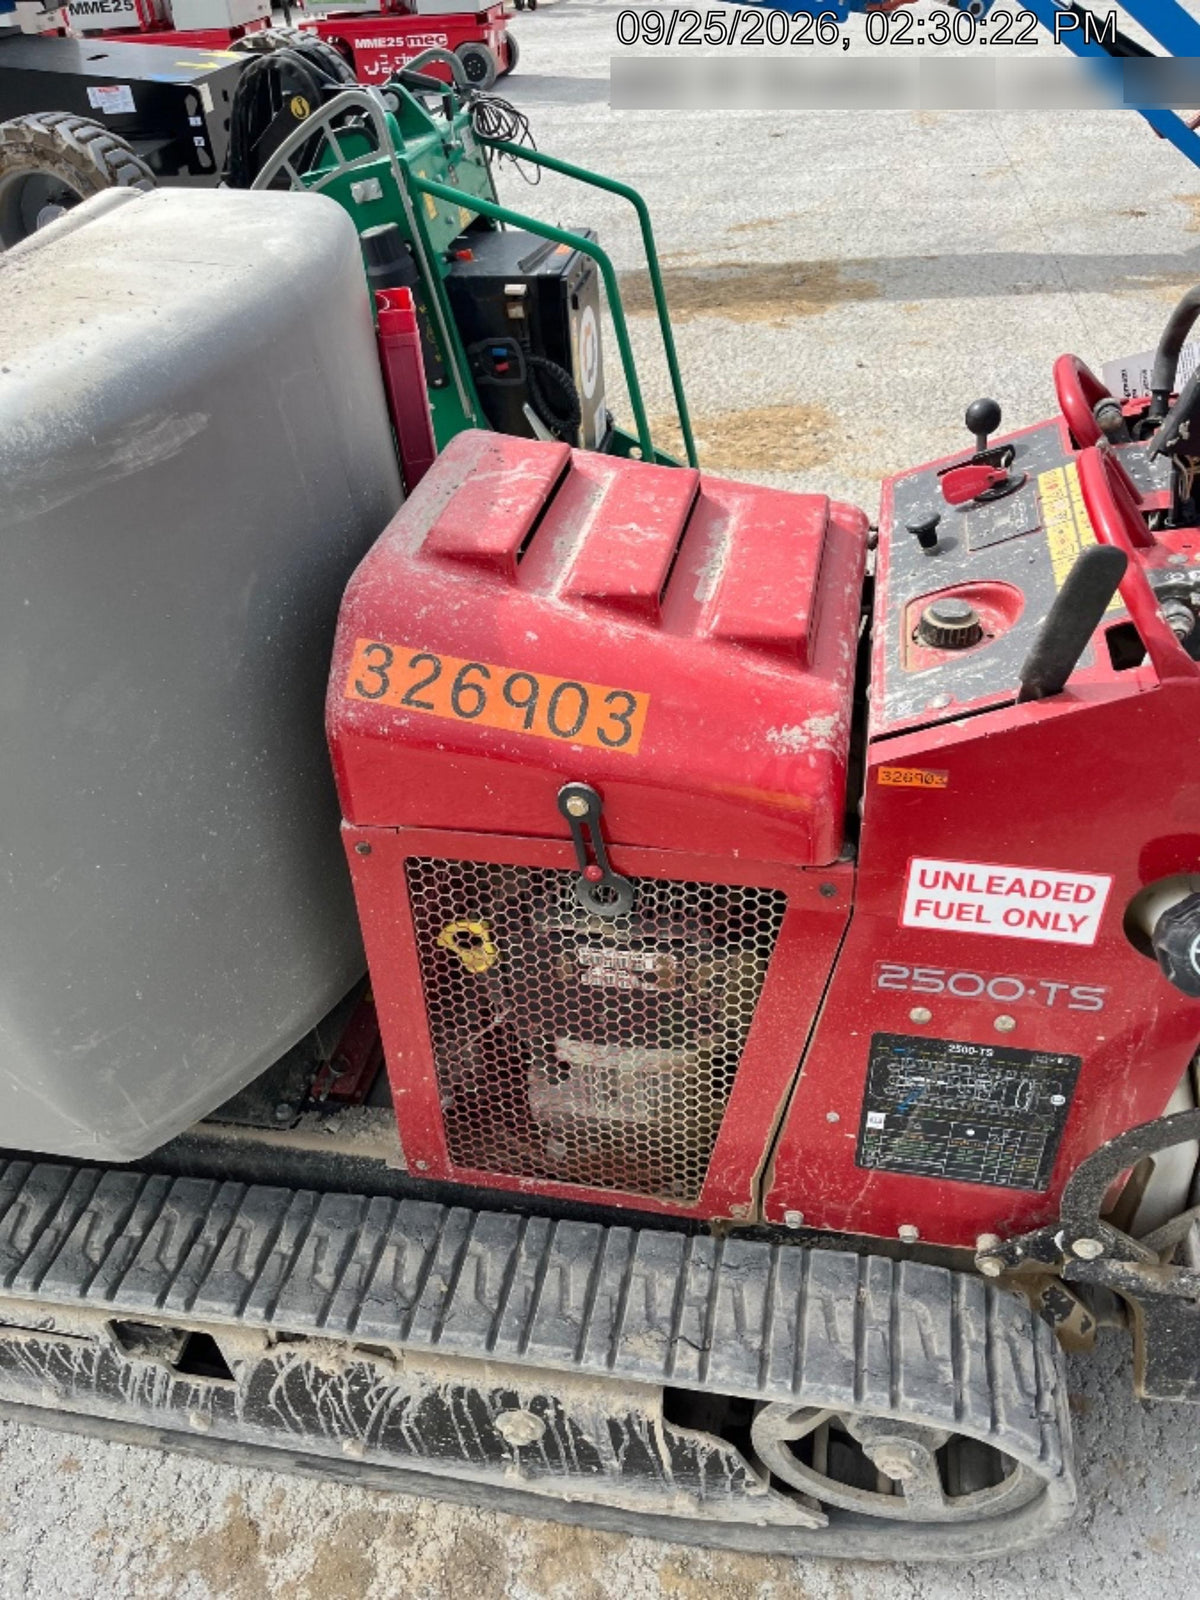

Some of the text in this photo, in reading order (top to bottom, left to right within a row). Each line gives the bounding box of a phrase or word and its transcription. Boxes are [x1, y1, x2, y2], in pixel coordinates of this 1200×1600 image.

[69, 0, 135, 15] MME25
[355, 37, 404, 49] MME25
[355, 643, 637, 747] 326903
[918, 869, 1096, 904] UNLEADED
[914, 899, 1089, 933] FUEL ONLY
